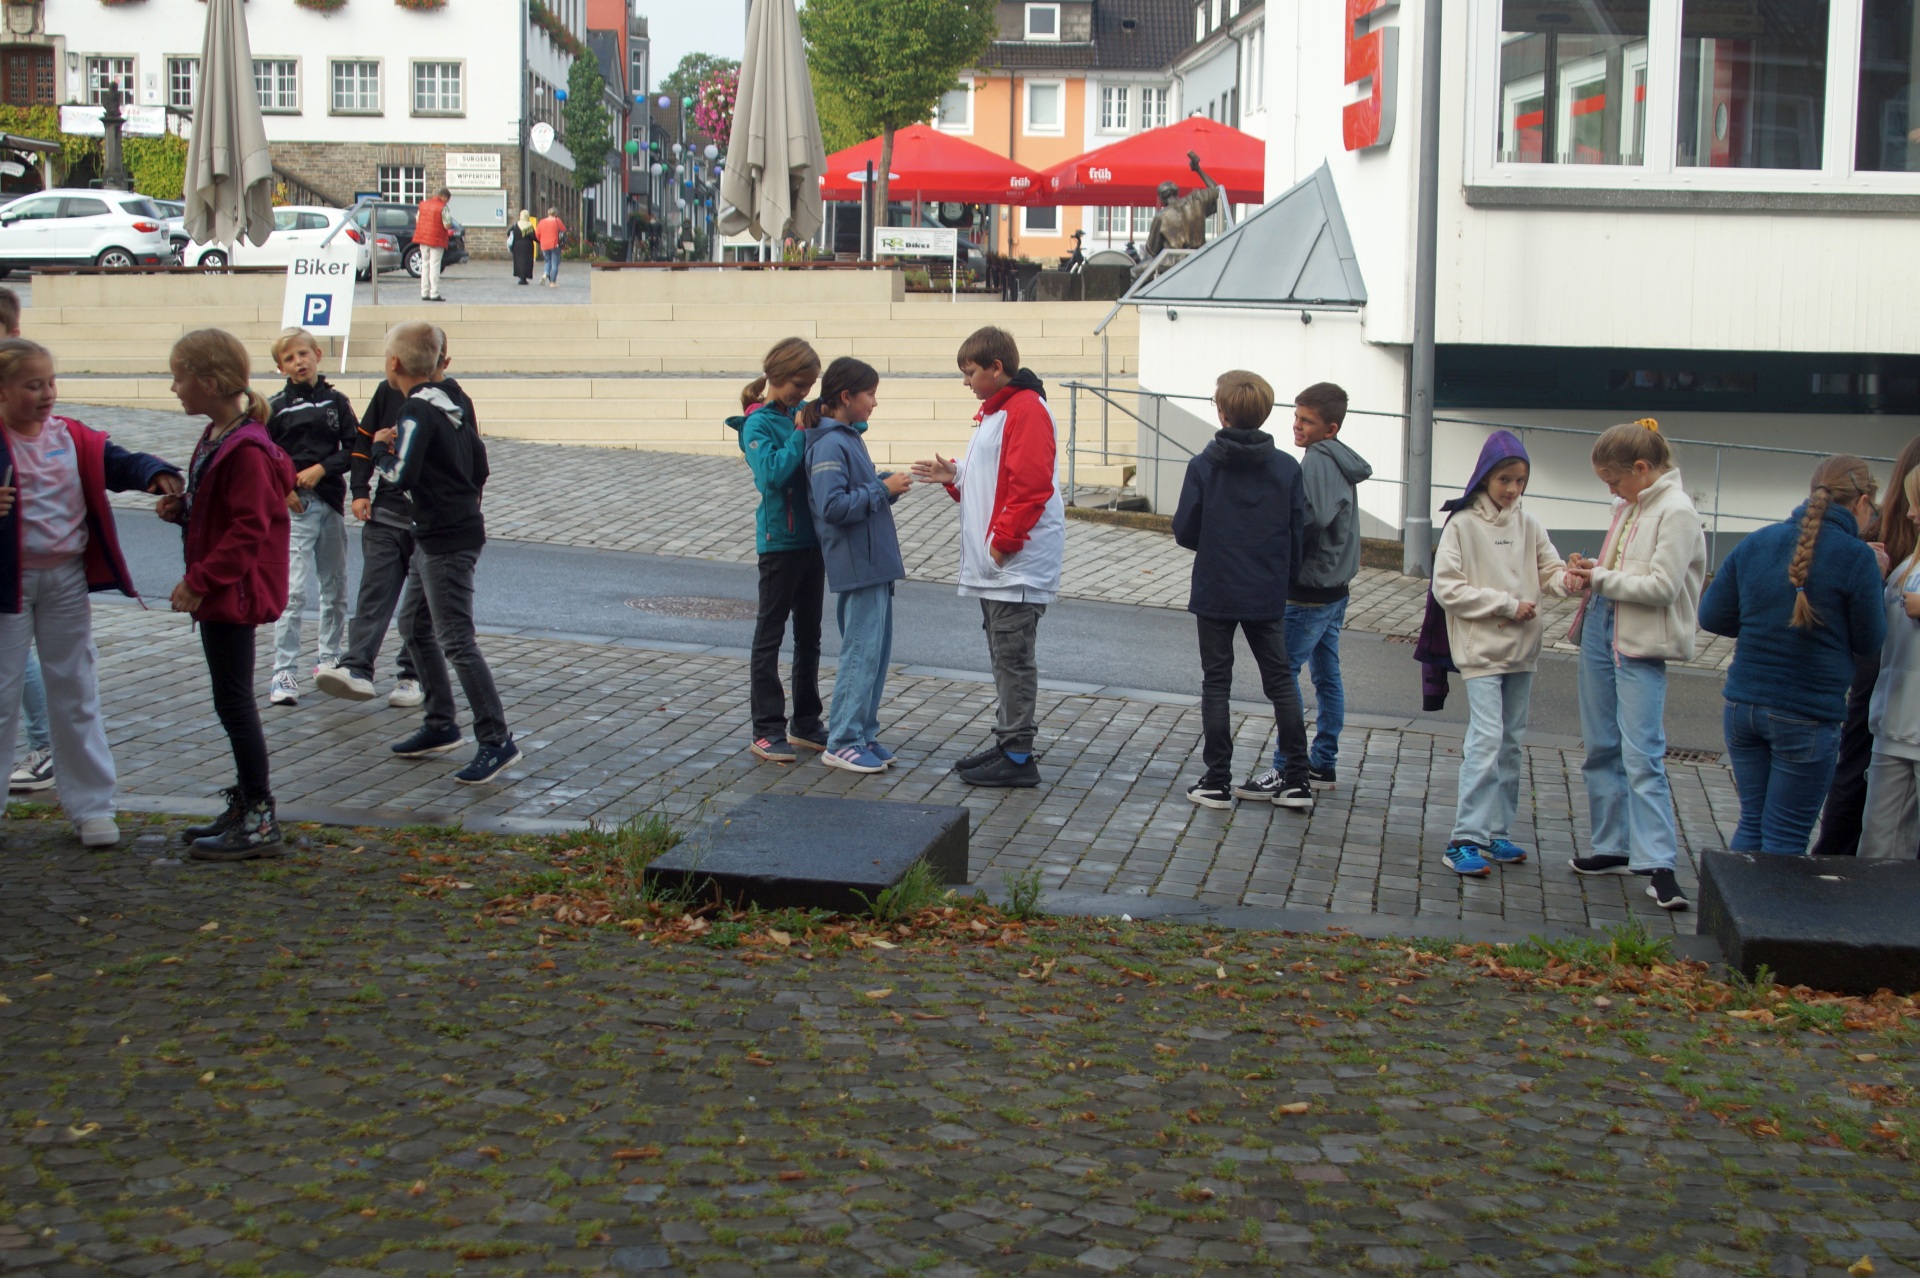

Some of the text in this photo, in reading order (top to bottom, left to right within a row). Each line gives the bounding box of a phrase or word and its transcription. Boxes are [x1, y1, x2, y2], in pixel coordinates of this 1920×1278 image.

[1010, 176, 1031, 188] früh
[1089, 167, 1112, 182] früh
[294, 258, 350, 275] Biker
[307, 298, 327, 323] P
